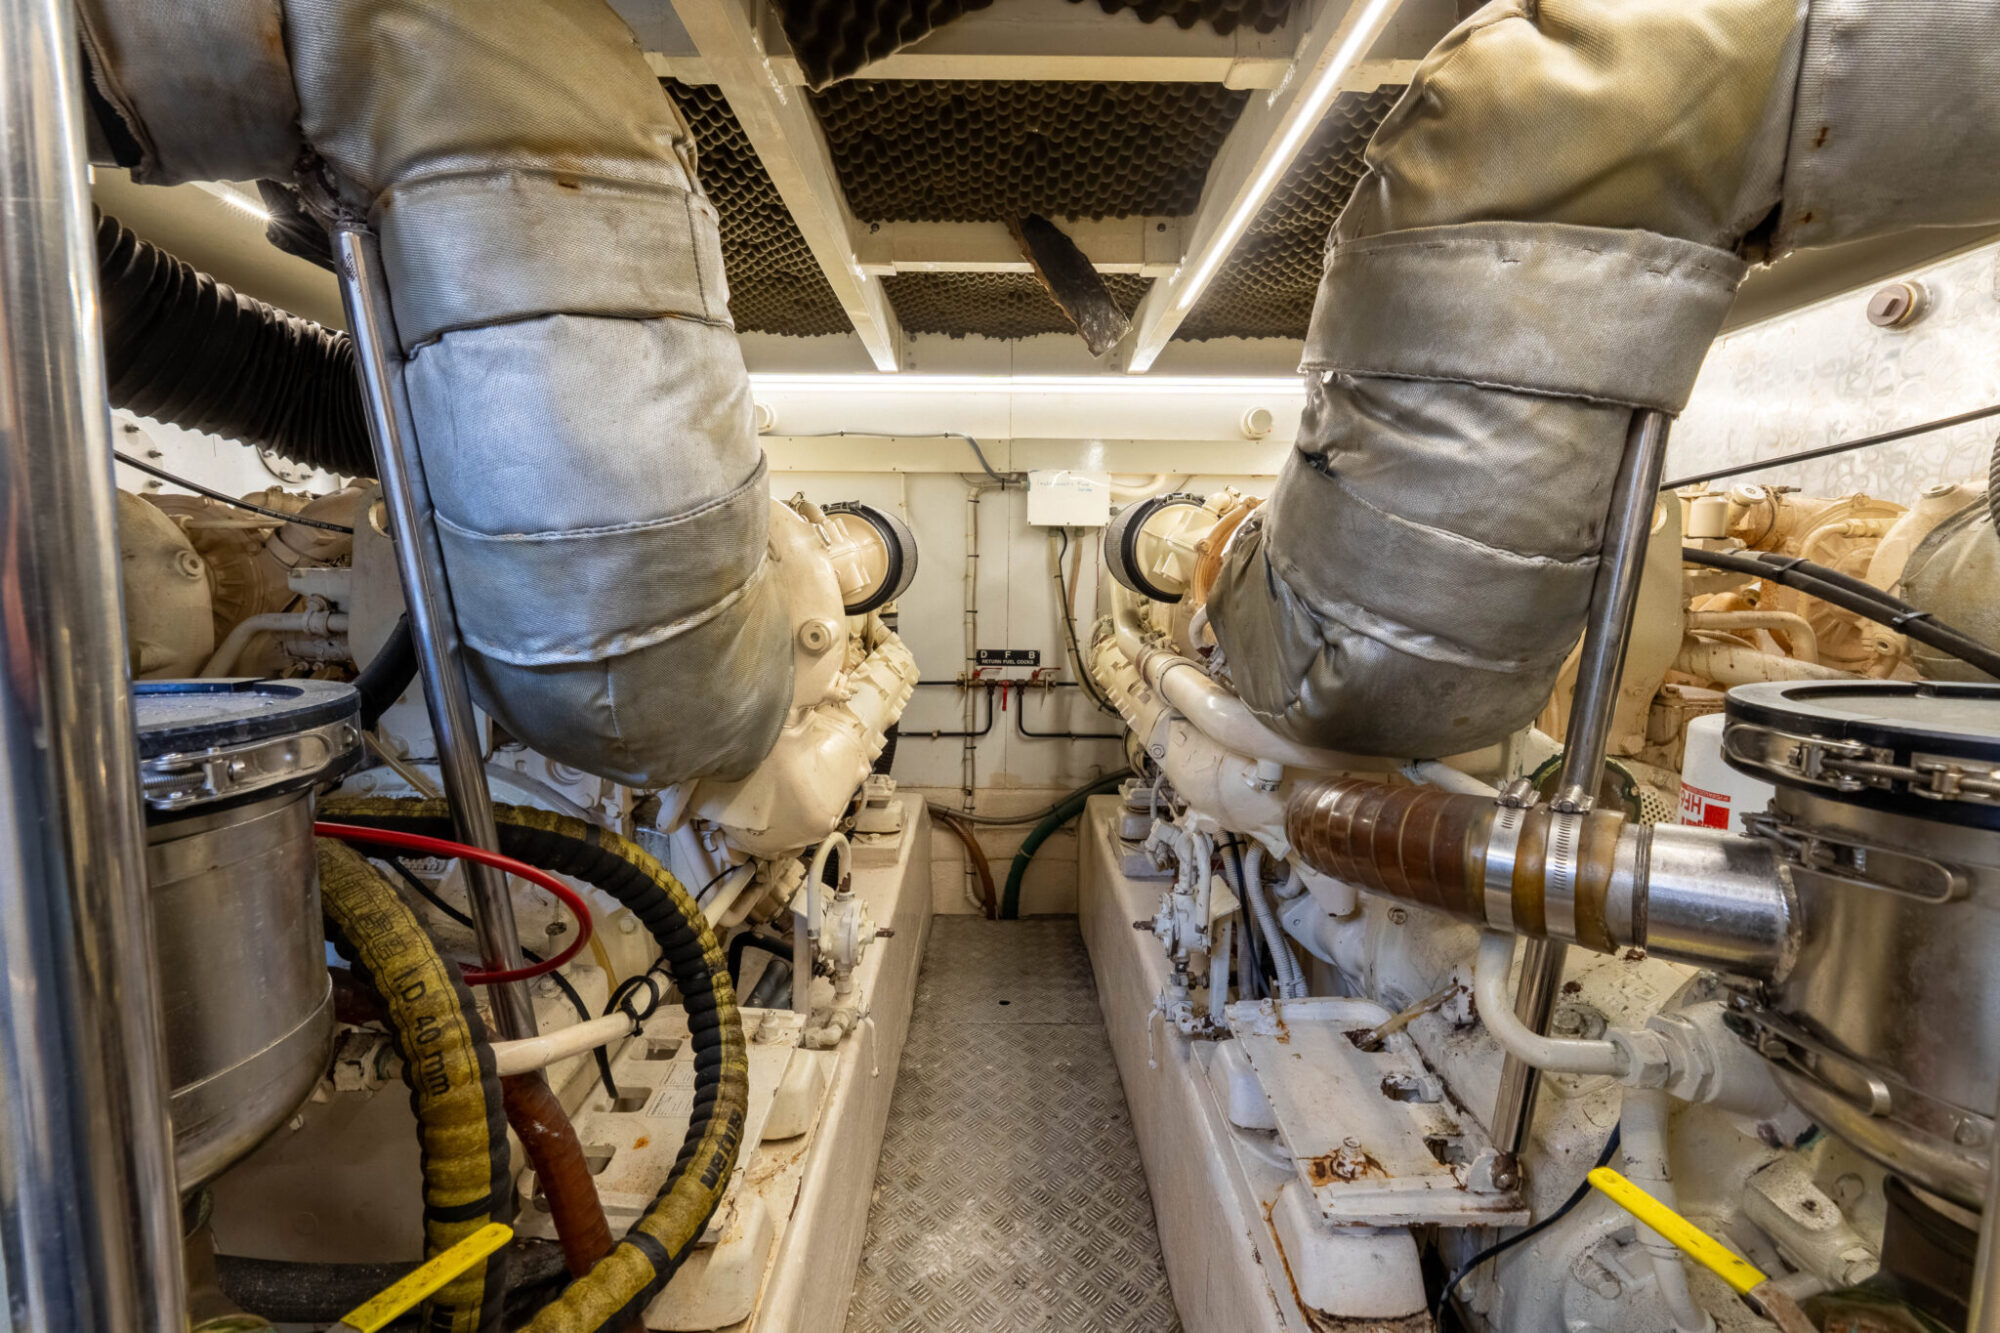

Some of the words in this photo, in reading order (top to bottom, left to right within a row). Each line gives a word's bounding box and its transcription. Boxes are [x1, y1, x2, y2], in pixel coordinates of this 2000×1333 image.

[1028, 651, 1036, 659] B
[415, 1015, 442, 1046] 40
[424, 1049, 450, 1097] mm
